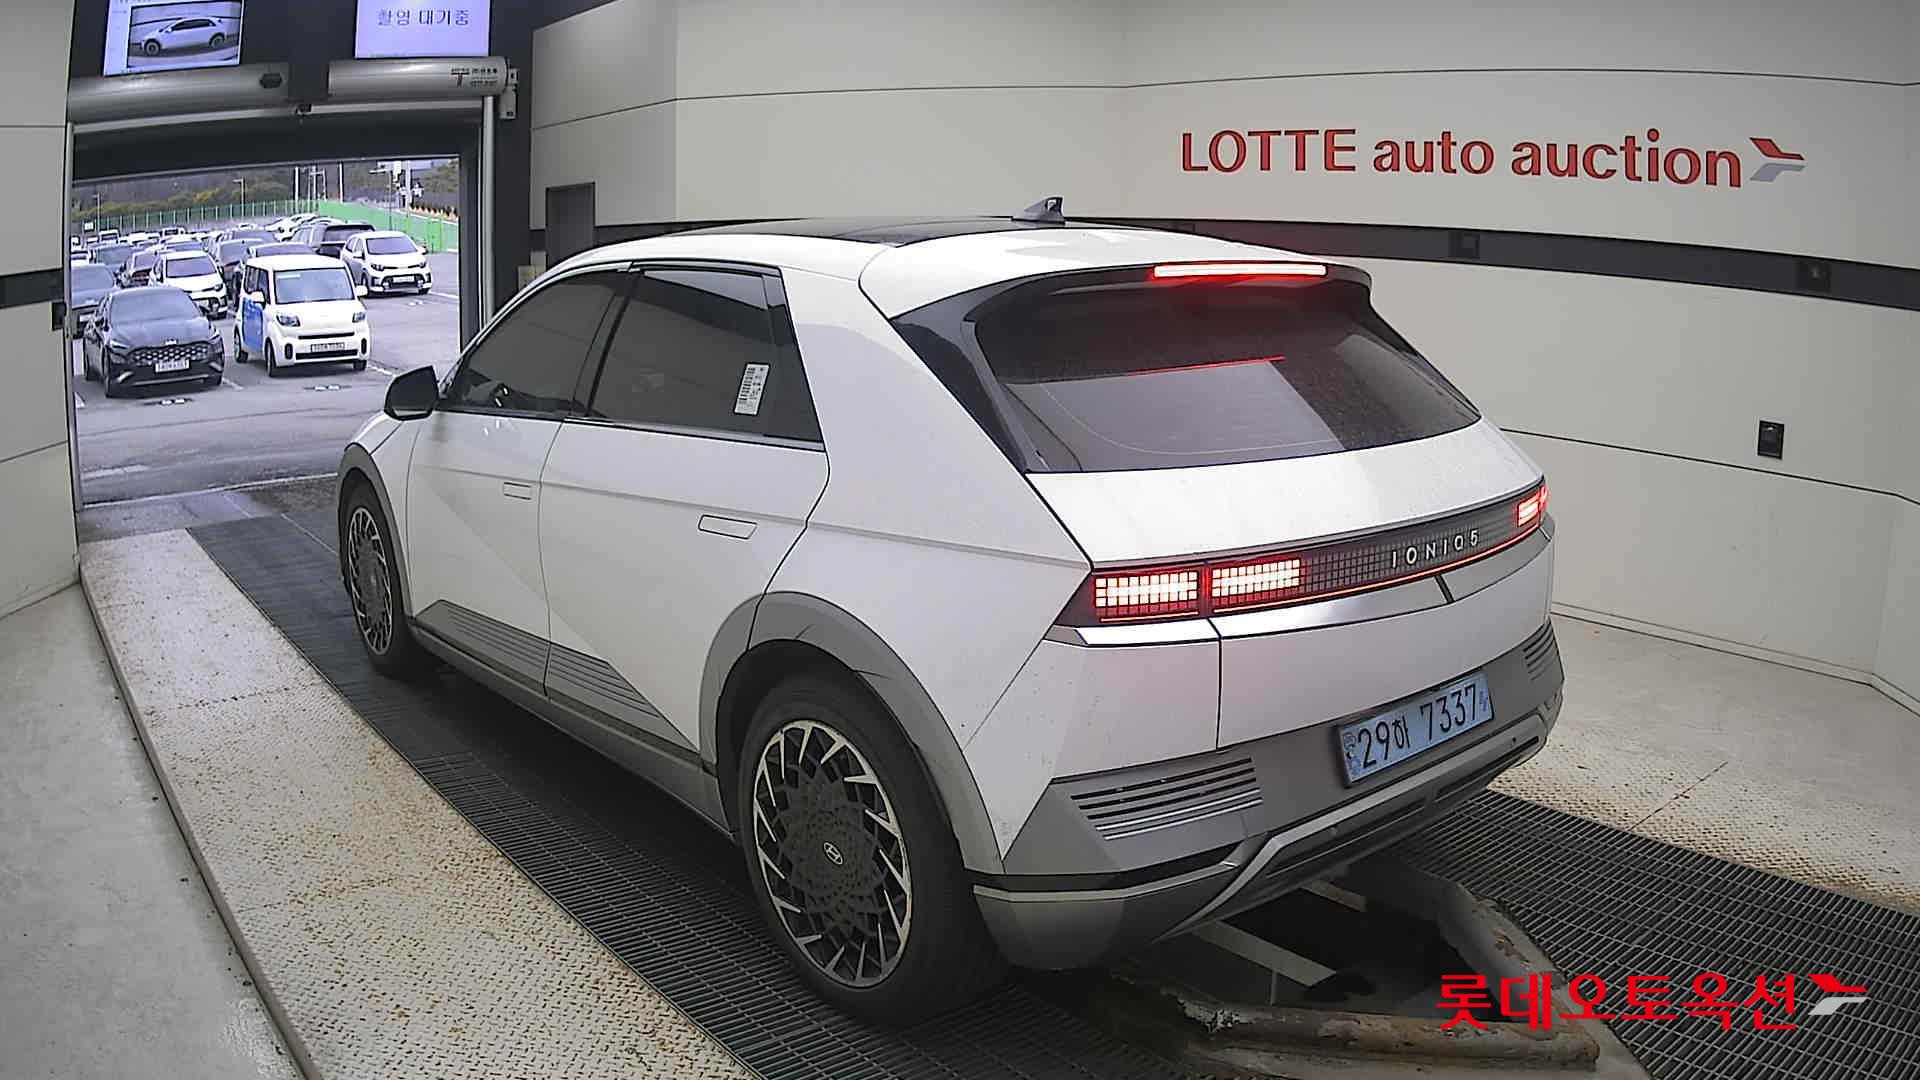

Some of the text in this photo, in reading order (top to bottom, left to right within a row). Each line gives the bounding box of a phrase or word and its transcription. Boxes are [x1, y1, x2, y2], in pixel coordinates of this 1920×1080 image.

[419, 9, 469, 26] 대기중
[1181, 128, 1742, 188] LOTTE auto auction
[1357, 715, 1411, 769] 29하
[1419, 683, 1477, 741] 7337
